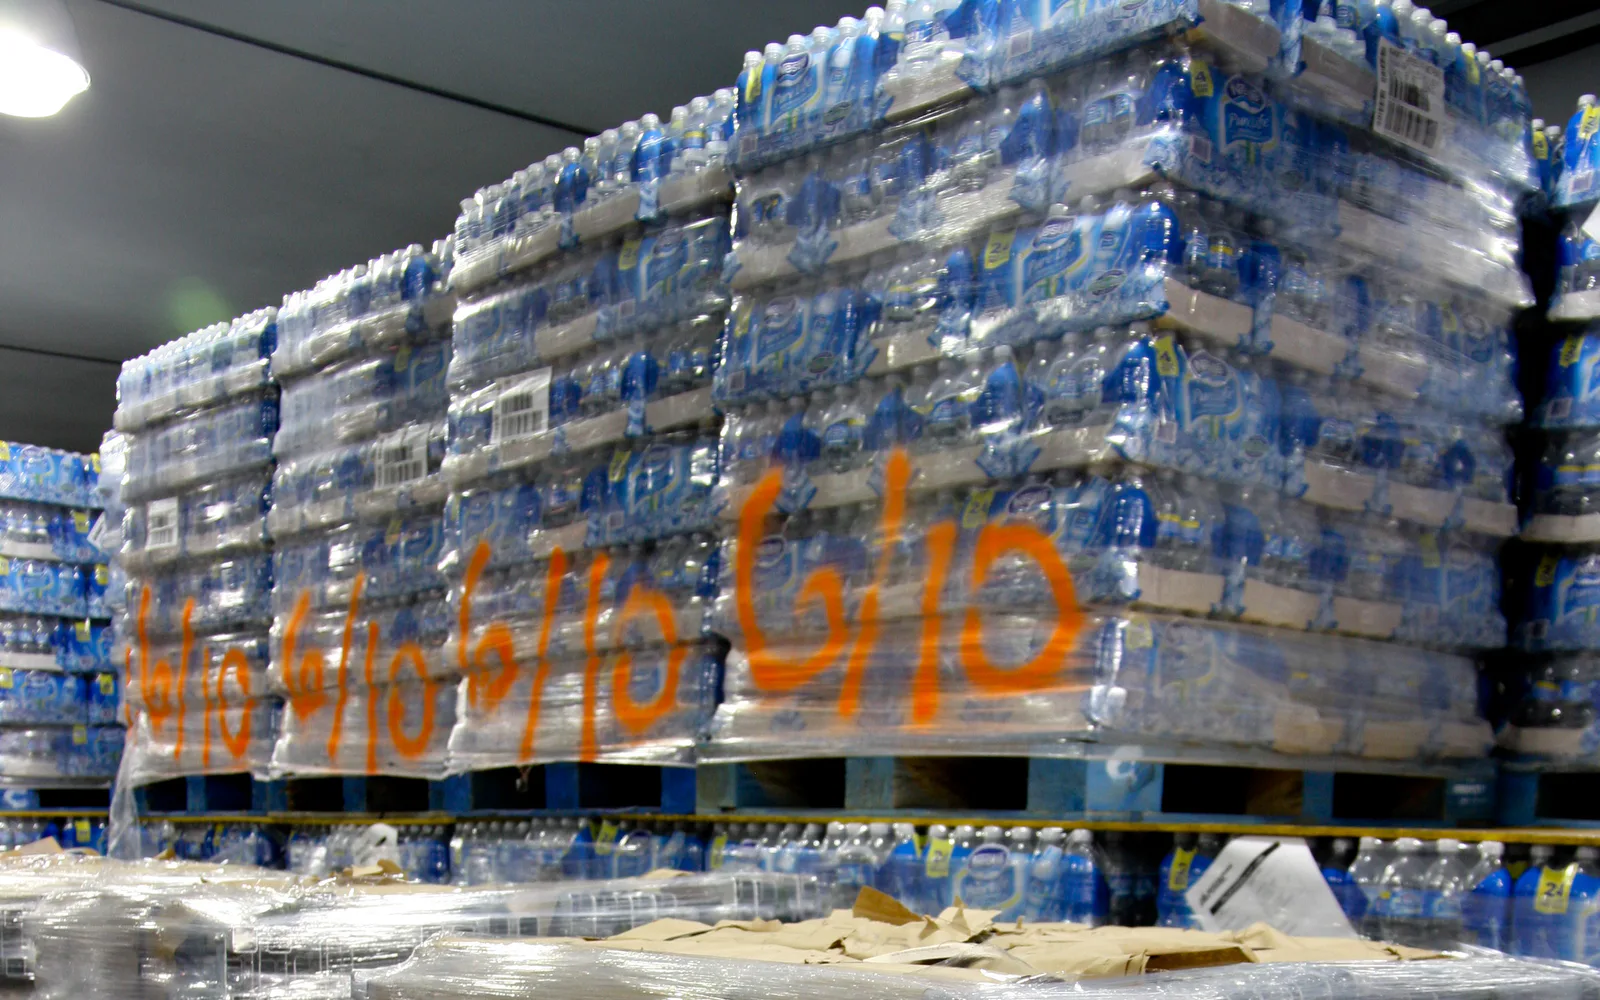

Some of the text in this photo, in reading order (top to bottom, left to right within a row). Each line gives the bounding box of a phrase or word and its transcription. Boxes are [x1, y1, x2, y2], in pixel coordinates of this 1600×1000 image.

[138, 586, 256, 769] 6/10
[283, 570, 440, 775] 6/10
[458, 541, 689, 762] 6/10
[737, 447, 1084, 727] 6/10
